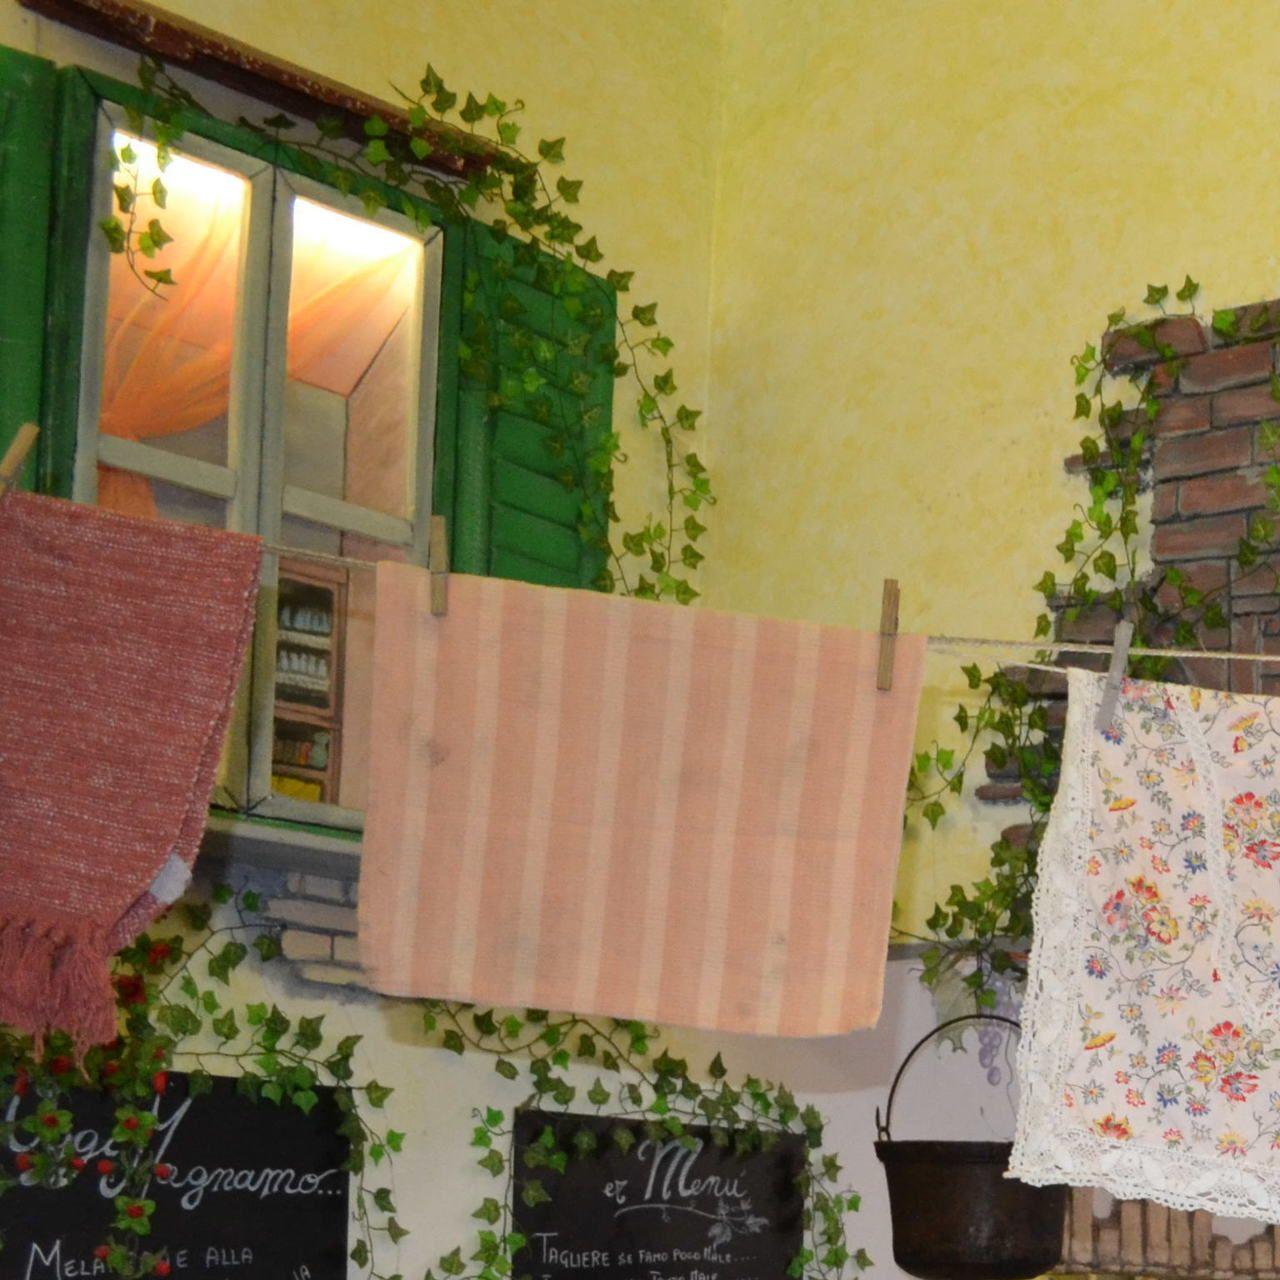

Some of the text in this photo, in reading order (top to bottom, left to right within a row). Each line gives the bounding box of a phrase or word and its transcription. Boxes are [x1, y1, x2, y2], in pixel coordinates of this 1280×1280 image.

[206, 1246, 253, 1269] ALLA
[532, 1232, 610, 1269] TAGLIERE
[639, 1249, 669, 1264] FAMO
[672, 1247, 701, 1262] POCO
